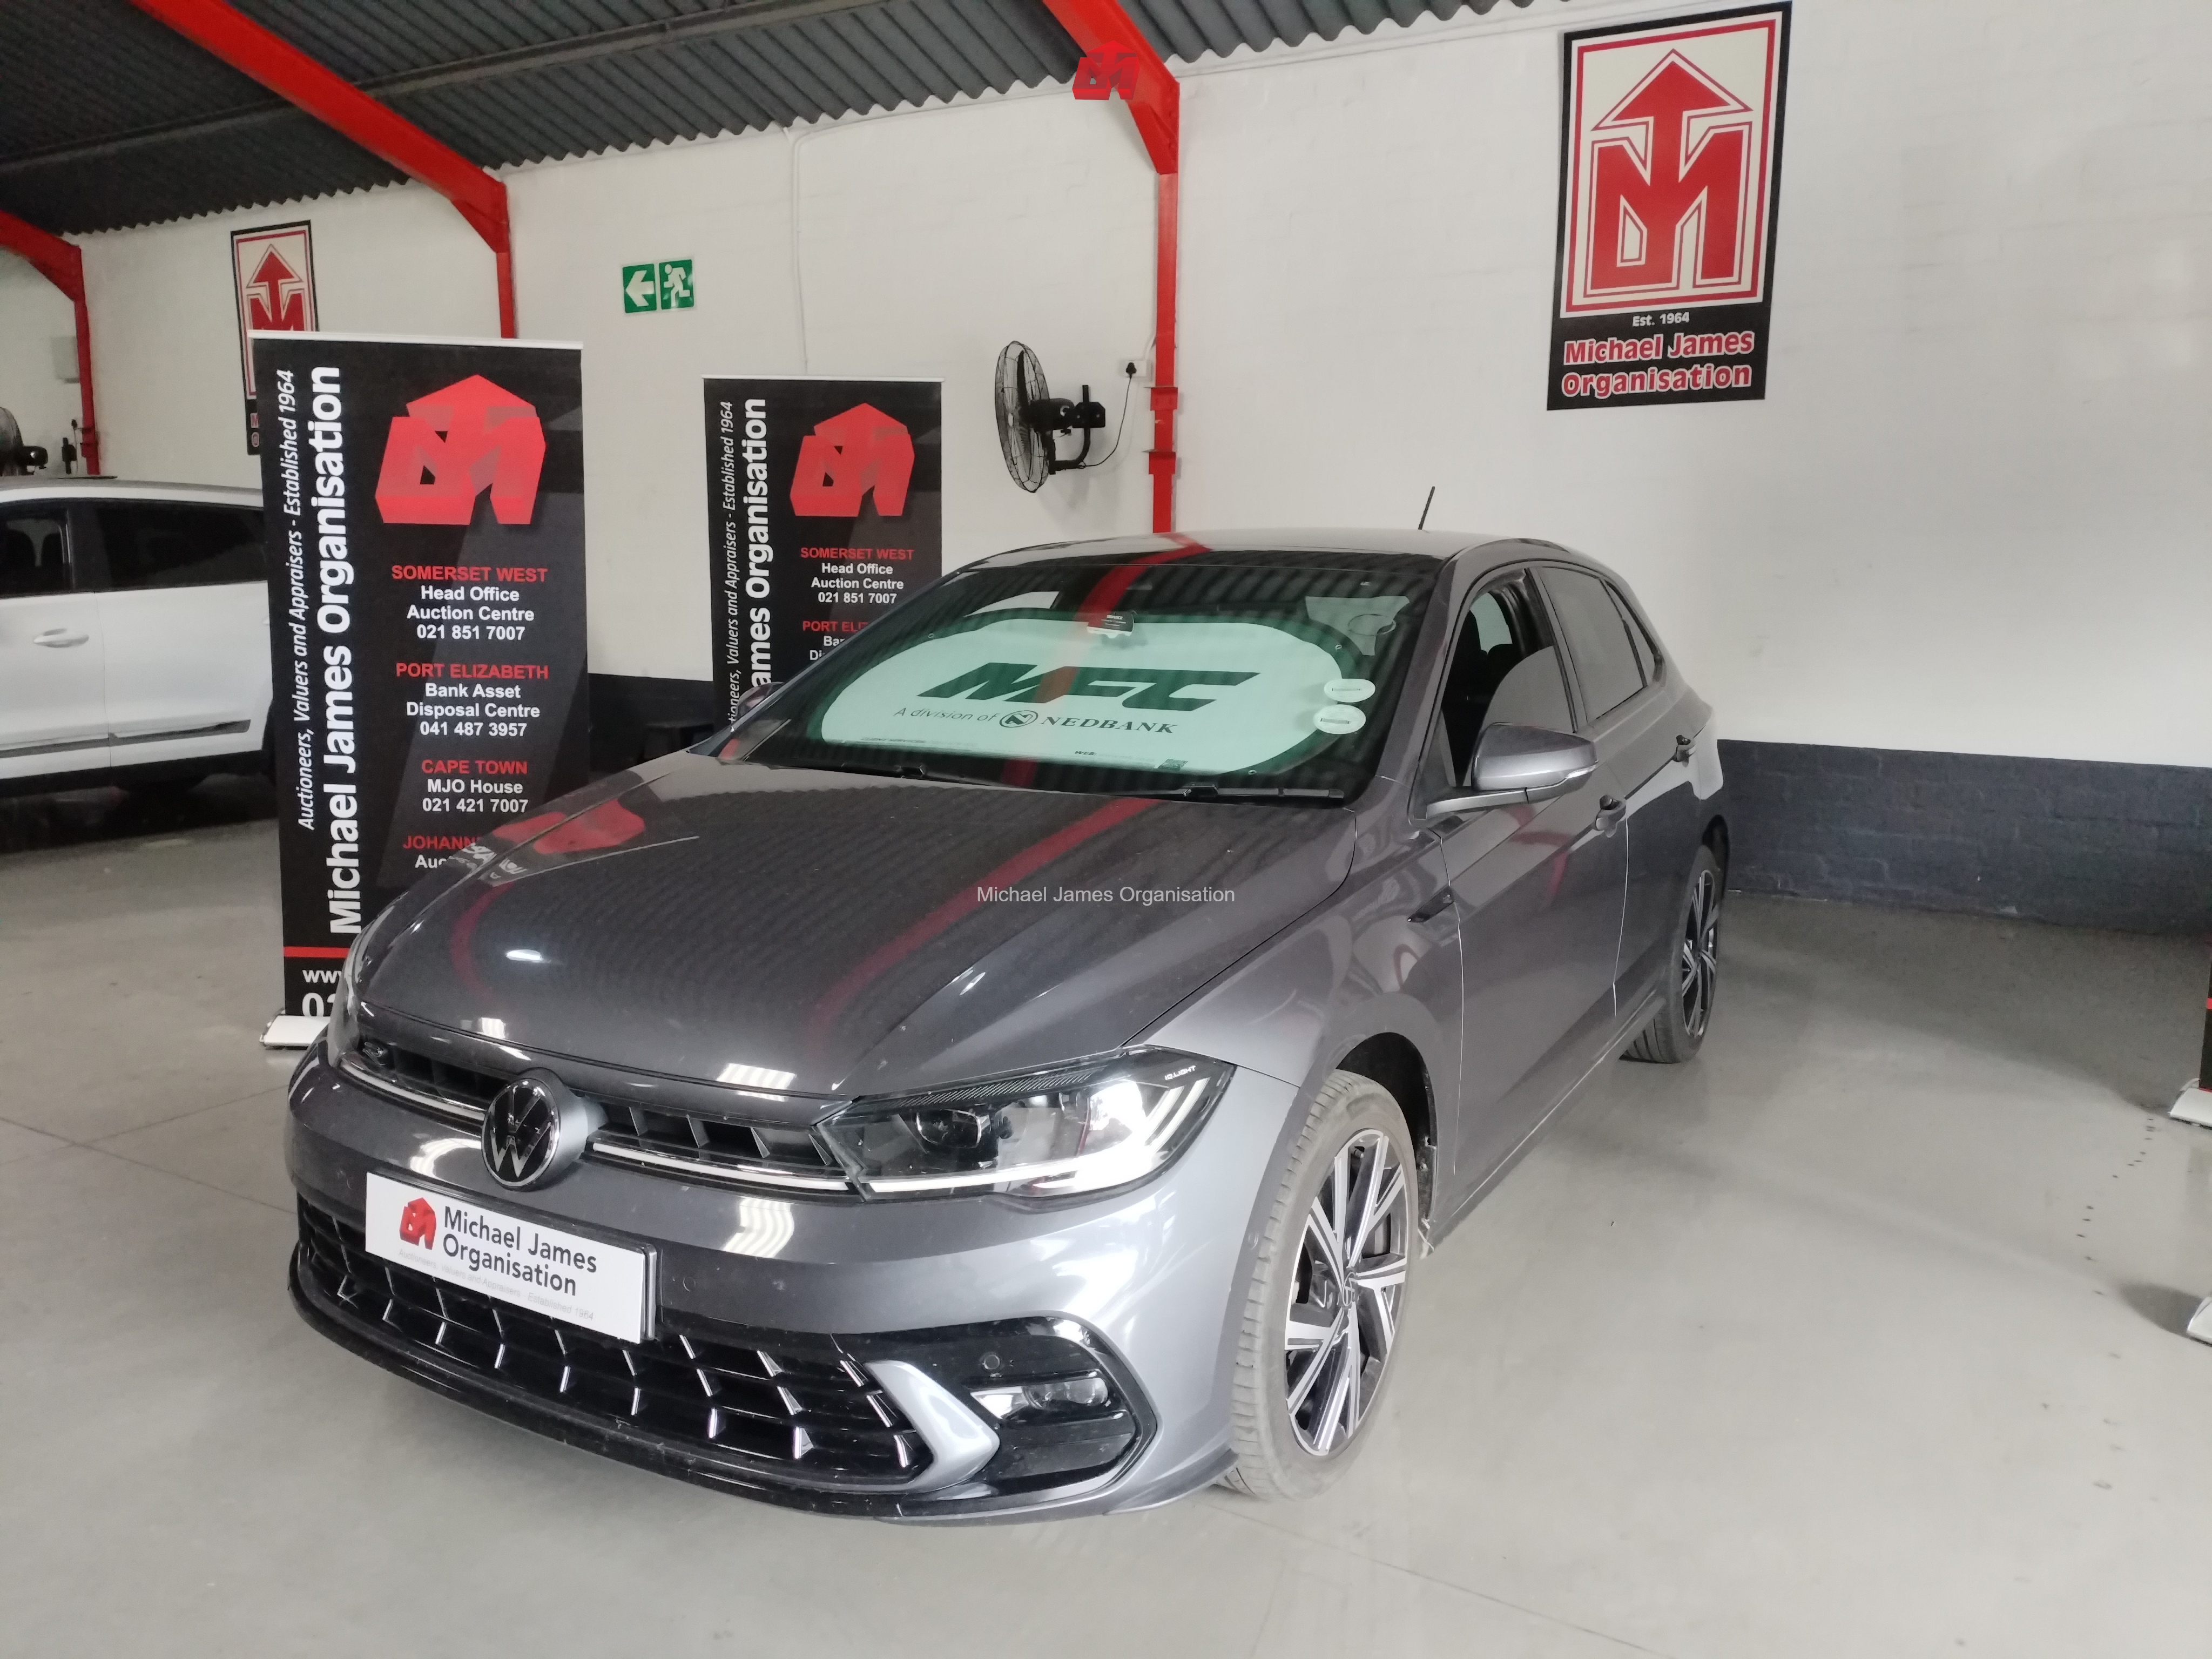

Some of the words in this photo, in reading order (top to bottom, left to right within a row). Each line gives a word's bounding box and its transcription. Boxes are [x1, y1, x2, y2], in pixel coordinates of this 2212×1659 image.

[1632, 315, 1655, 327] Est.
[1660, 312, 1690, 325] 1964
[1563, 334, 1663, 366] Michael
[1667, 330, 1755, 358] James
[276, 369, 296, 413] 1964
[1561, 363, 1752, 399] Organisation
[720, 401, 733, 434] 1964
[279, 416, 301, 516] Established
[720, 436, 736, 511] Established
[308, 367, 354, 633] Organisation
[741, 399, 773, 598] Organisation
[723, 521, 740, 588] Appraisers
[801, 547, 873, 559] SOMERSET
[876, 548, 914, 560] WEST
[821, 562, 854, 574] Head
[857, 563, 893, 575] Office
[285, 530, 309, 621] Appraisers
[393, 565, 492, 581] SOMERSET
[496, 568, 549, 583] WEST
[811, 577, 859, 589] Auction
[862, 578, 904, 590] Centre
[421, 585, 465, 601] Head
[469, 586, 520, 602] Office
[724, 589, 739, 617] and
[818, 591, 839, 603] 021
[843, 592, 864, 603] 851
[868, 592, 897, 604] 7007
[407, 604, 474, 620] Auction
[478, 605, 535, 621] Centre
[803, 621, 838, 631] PORT
[288, 622, 308, 657] and
[416, 624, 445, 639] 021
[451, 625, 480, 639] 851
[486, 625, 525, 640] 7007
[726, 618, 739, 664] Valuers
[750, 608, 772, 687] ames
[397, 663, 445, 677] PORT
[450, 664, 549, 679] ELIZABETH
[916, 662, 1261, 712] MFC
[292, 660, 311, 722] Valuers
[425, 682, 469, 698] Bank
[472, 683, 521, 698] Asset
[727, 669, 742, 724] tioneers,
[323, 645, 356, 773] James
[406, 702, 480, 720] Disposal
[484, 703, 540, 718] Centre
[893, 707, 907, 717] A
[910, 707, 974, 721] division
[977, 712, 1000, 723] of
[1039, 716, 1179, 734] NEDBANK
[420, 721, 448, 736] 041
[454, 721, 483, 736] 487
[488, 722, 528, 737] 3957
[297, 729, 315, 831] Auctioneers,
[422, 759, 470, 774] CAPE
[475, 760, 528, 774] TOWN
[427, 778, 465, 793] MJO
[470, 779, 523, 794] House
[422, 798, 450, 812] 021
[456, 798, 483, 812] 421
[490, 799, 529, 813] 7007
[323, 784, 361, 934] Michael
[444, 1205, 521, 1251] Michael
[528, 1232, 597, 1273] James
[443, 1233, 576, 1296] Organisation
